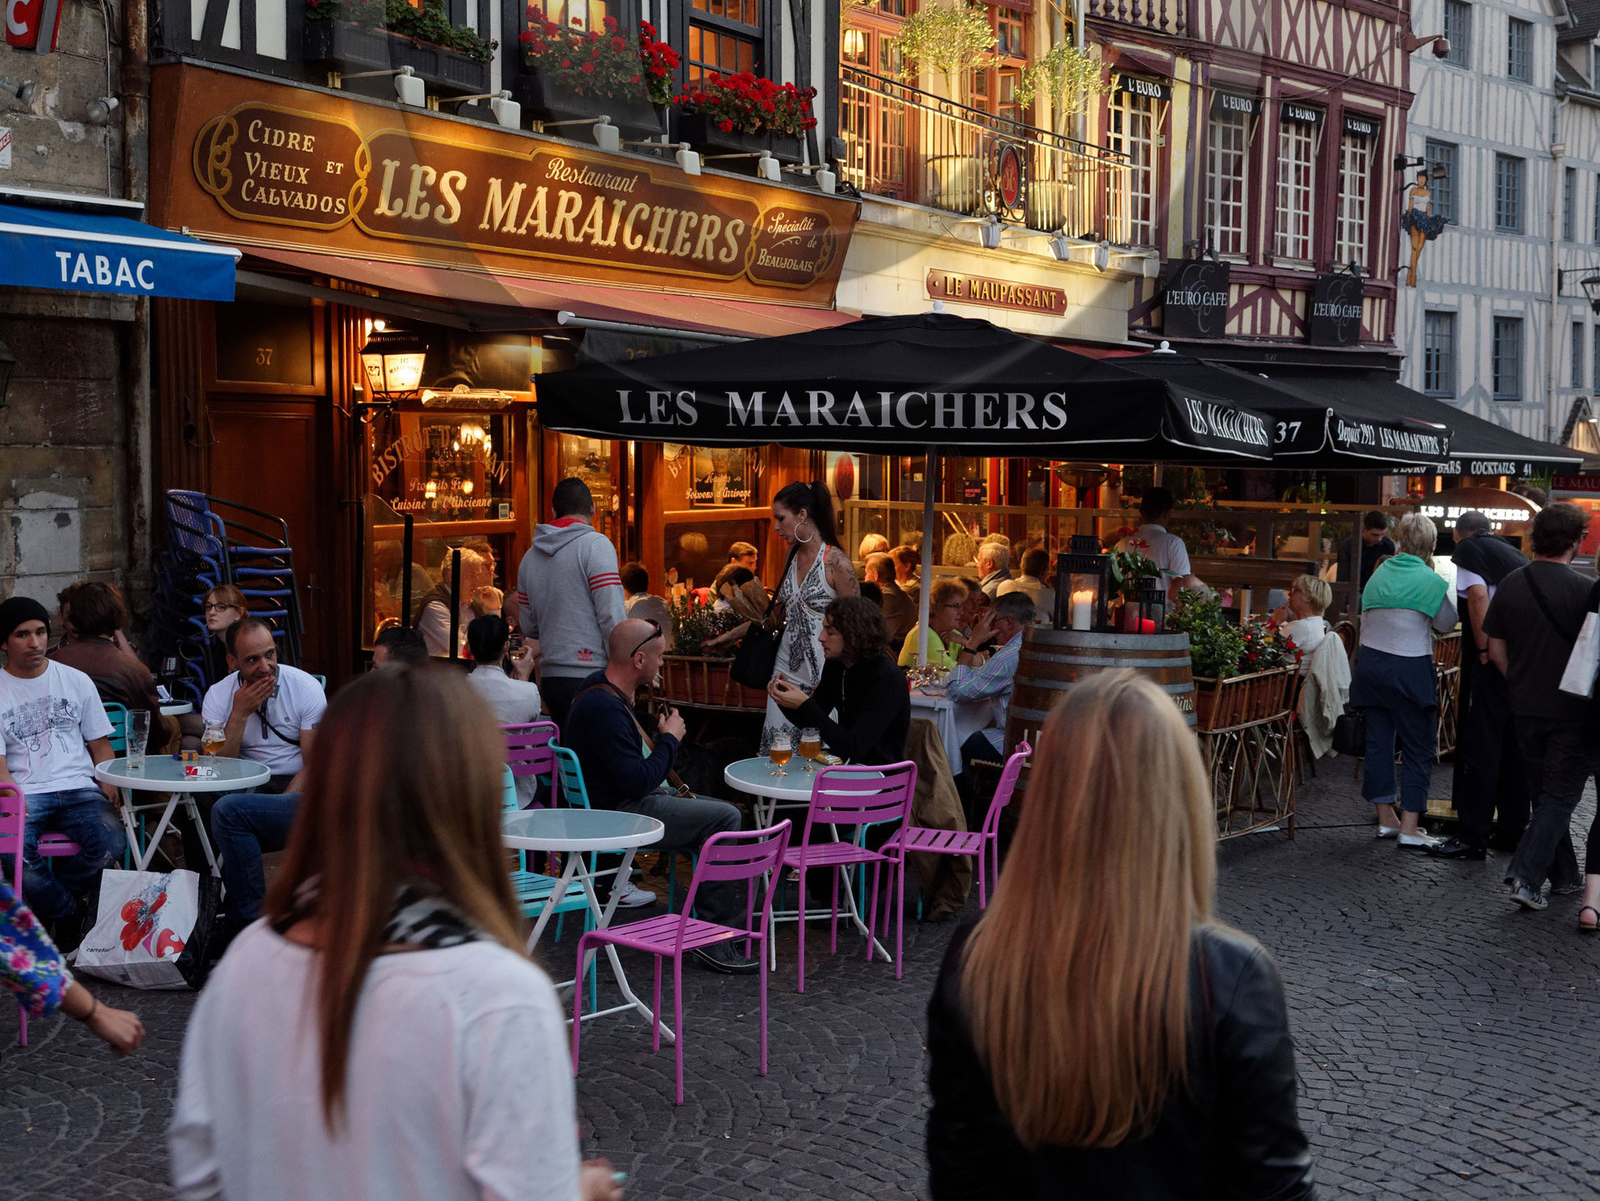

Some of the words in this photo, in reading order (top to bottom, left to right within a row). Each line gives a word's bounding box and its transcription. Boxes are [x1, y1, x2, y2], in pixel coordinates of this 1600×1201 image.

[1128, 78, 1161, 98] L'EURO
[1222, 94, 1252, 113] L'EURO
[248, 119, 316, 153] CIDRE
[244, 151, 310, 185] VIEUX
[325, 161, 344, 175] ET
[545, 158, 639, 194] Restaurant
[241, 178, 346, 215] CALVADOS
[373, 158, 467, 225] LES
[478, 177, 745, 263] MARAICHERS
[767, 212, 816, 239] Spécialité
[807, 235, 818, 248] de
[55, 251, 154, 290] TABAC
[757, 248, 814, 272] BEAUJOLAIS
[944, 276, 963, 296] LE
[969, 279, 1057, 309] MAUPASSANT
[1166, 291, 1201, 306] L'EURO
[1202, 292, 1228, 306] CAFE
[1313, 303, 1341, 317] L'EURO
[1342, 304, 1362, 318] CAFE
[256, 347, 273, 365] 37
[368, 366, 380, 376] 37
[617, 390, 698, 426] LES
[725, 390, 1068, 431] MARAICHERS
[1184, 397, 1208, 435] LES
[1207, 403, 1269, 447] MARAICHERS
[1273, 421, 1302, 443] 37
[1337, 419, 1361, 448] Depuis
[1360, 423, 1376, 446] 1912
[1379, 427, 1394, 449] LES
[1393, 430, 1440, 455] MARAICHERS
[372, 427, 432, 487] BISTROT
[1436, 460, 1462, 475] BARS
[1471, 461, 1516, 476] COCKTAILS
[1523, 463, 1532, 476] 41
[409, 477, 449, 492] Proits
[1553, 476, 1566, 488] LE
[390, 496, 427, 511] Cuisine
[1420, 506, 1444, 517] LES
[1448, 507, 1530, 521] MAICHERS
